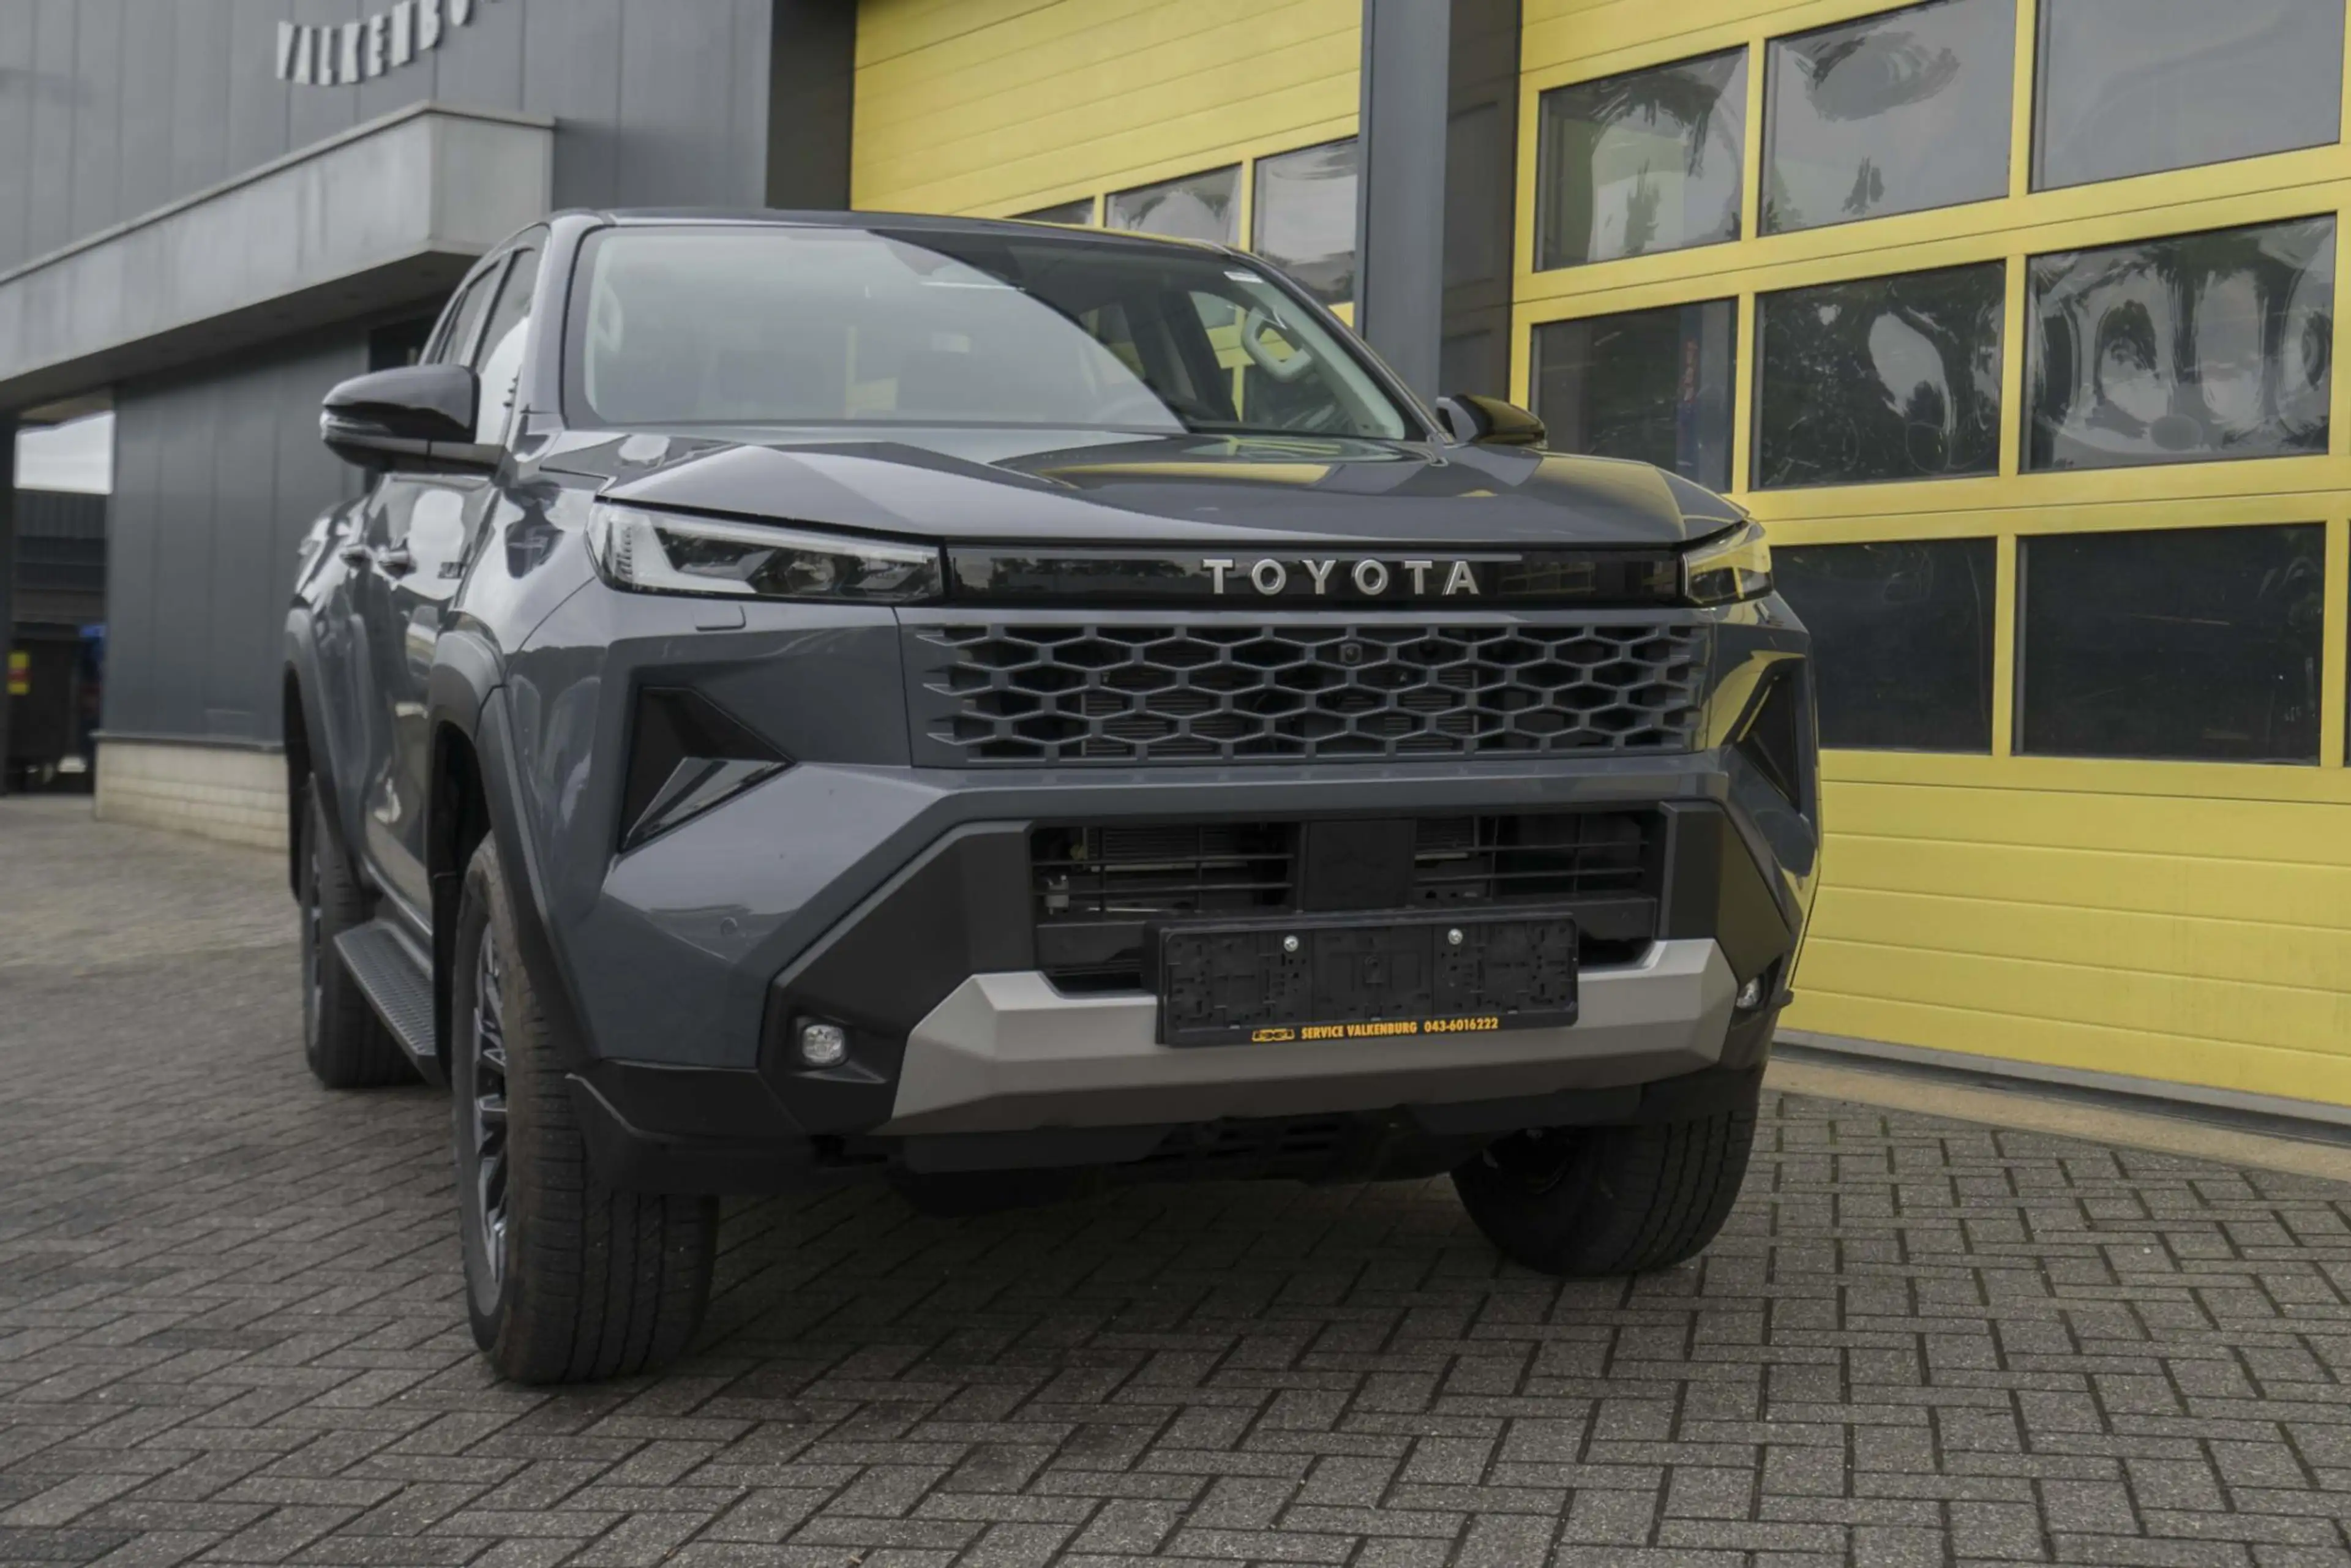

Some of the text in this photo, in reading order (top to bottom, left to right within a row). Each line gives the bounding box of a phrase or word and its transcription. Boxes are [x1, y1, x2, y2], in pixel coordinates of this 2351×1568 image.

[1202, 558, 1480, 596] TOYOTA
[1301, 1025, 1344, 1040] SERVICE
[1347, 1021, 1417, 1037] VALKENBURG
[1423, 1017, 1498, 1032] 043-6016222
